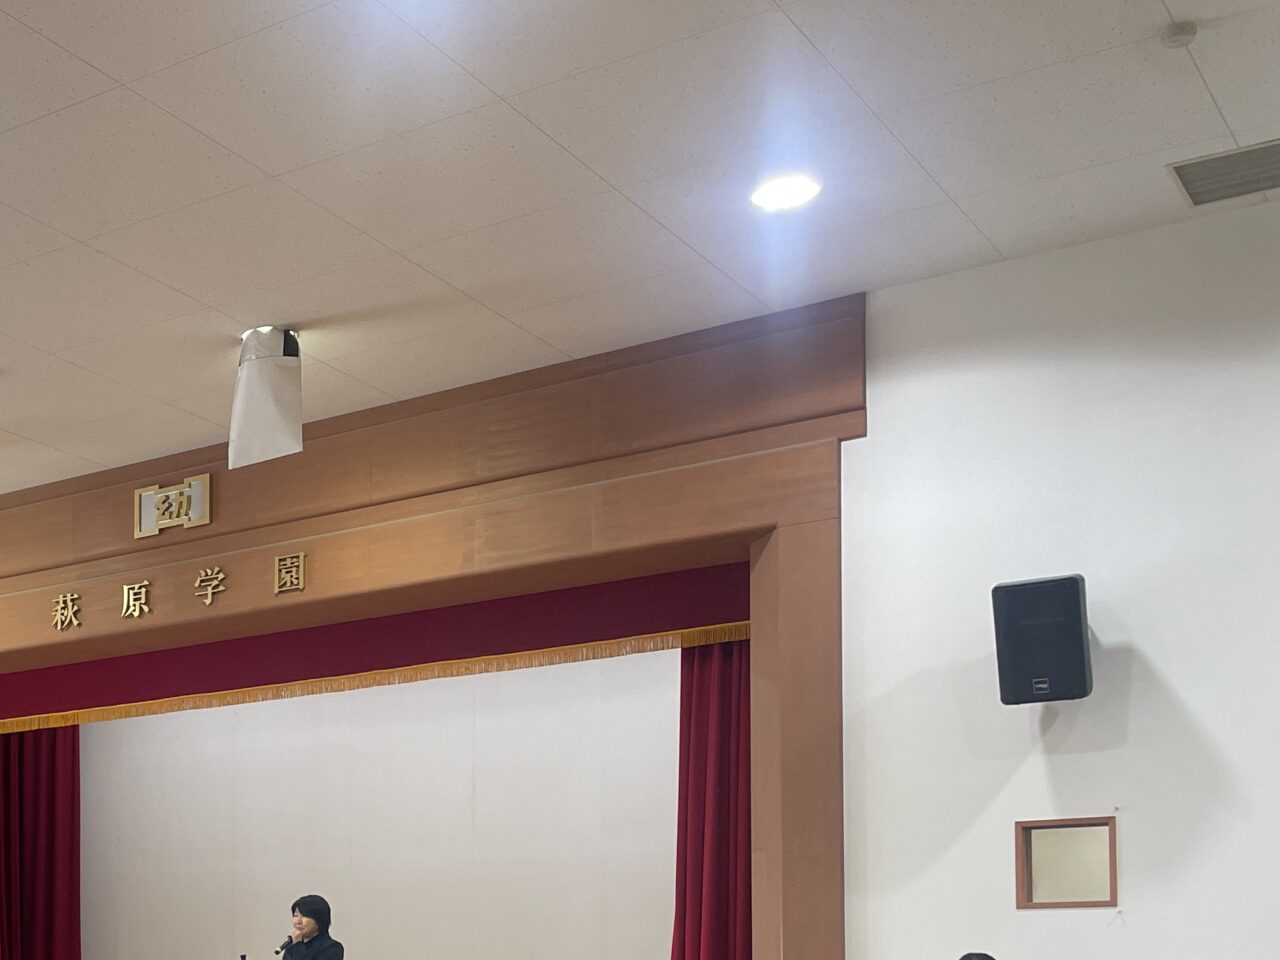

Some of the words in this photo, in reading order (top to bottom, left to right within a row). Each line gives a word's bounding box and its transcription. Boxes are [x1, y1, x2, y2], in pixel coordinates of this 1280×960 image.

[155, 490, 191, 521] 幼
[51, 552, 306, 631] 萩原学園
